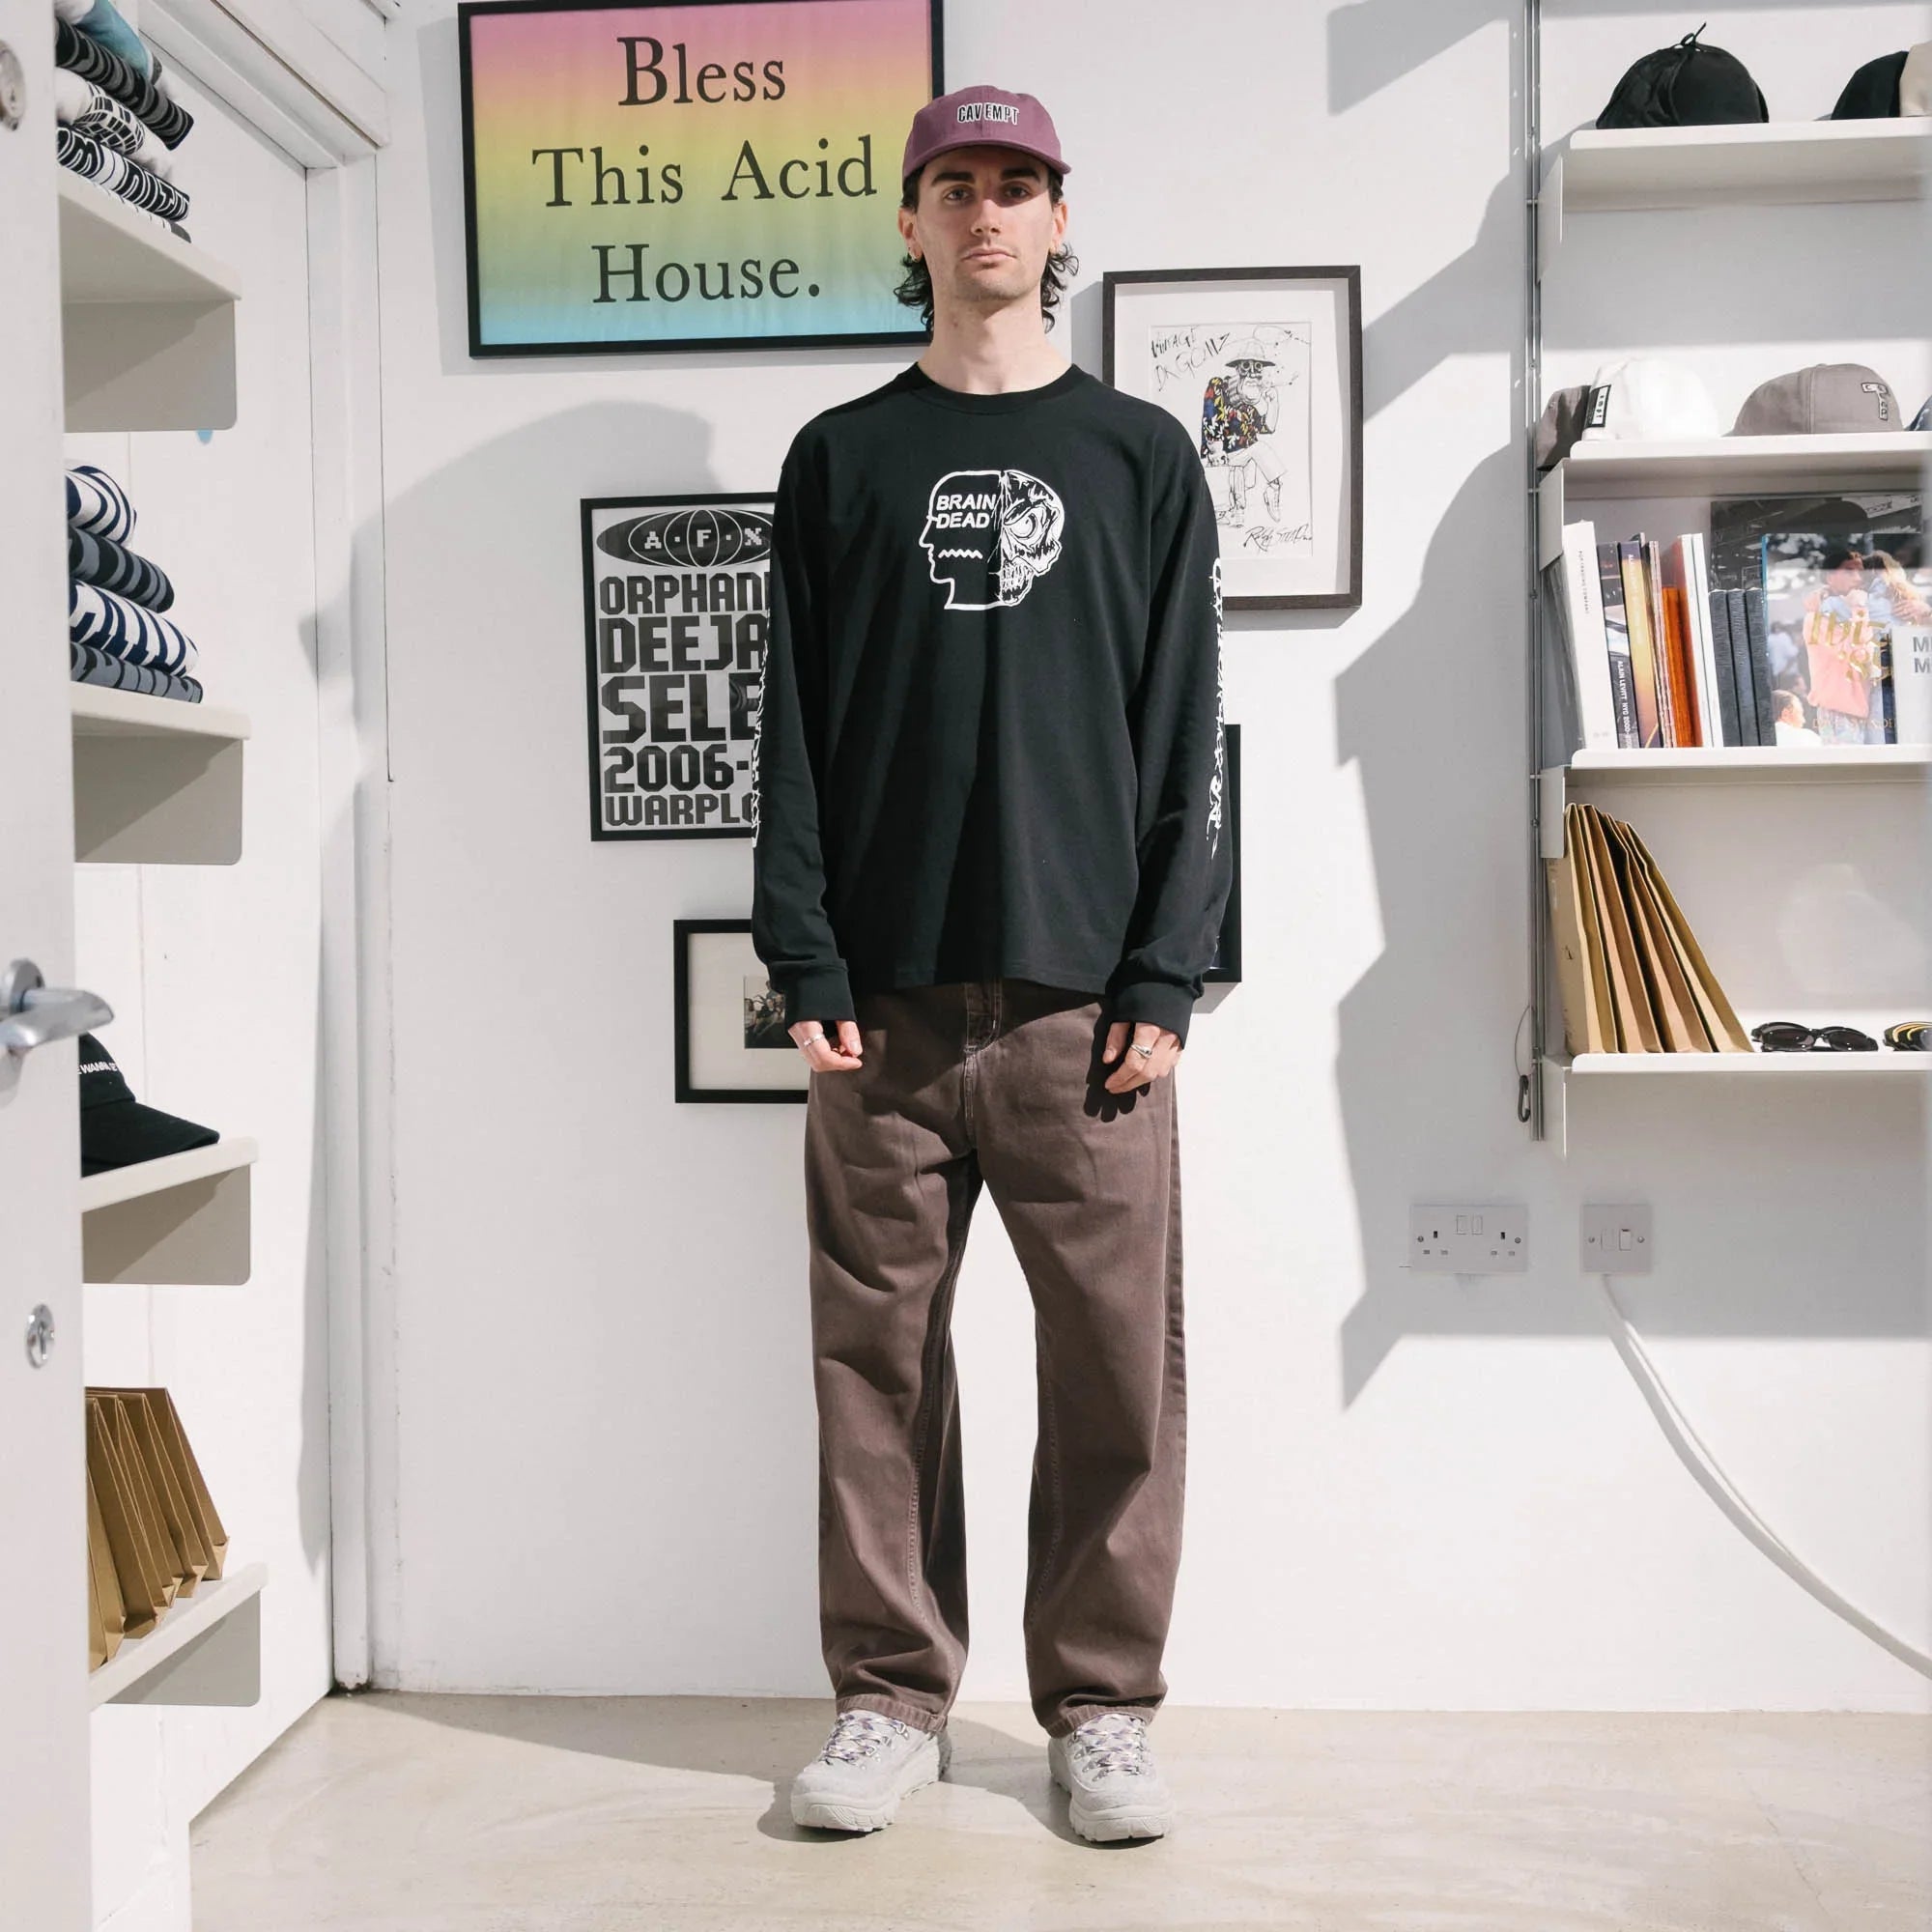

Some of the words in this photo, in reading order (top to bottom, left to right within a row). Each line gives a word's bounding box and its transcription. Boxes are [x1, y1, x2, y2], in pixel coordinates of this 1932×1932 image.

[616, 36, 786, 106] Bless
[957, 102, 982, 124] CAV
[984, 102, 1019, 126] EMPT
[532, 144, 683, 207] This
[721, 133, 877, 201] Acid
[591, 243, 819, 303] House.
[935, 512, 990, 529] DEAD
[936, 494, 996, 511] BRAIN
[600, 572, 770, 615] ORPHAN
[603, 743, 750, 793] 2006-
